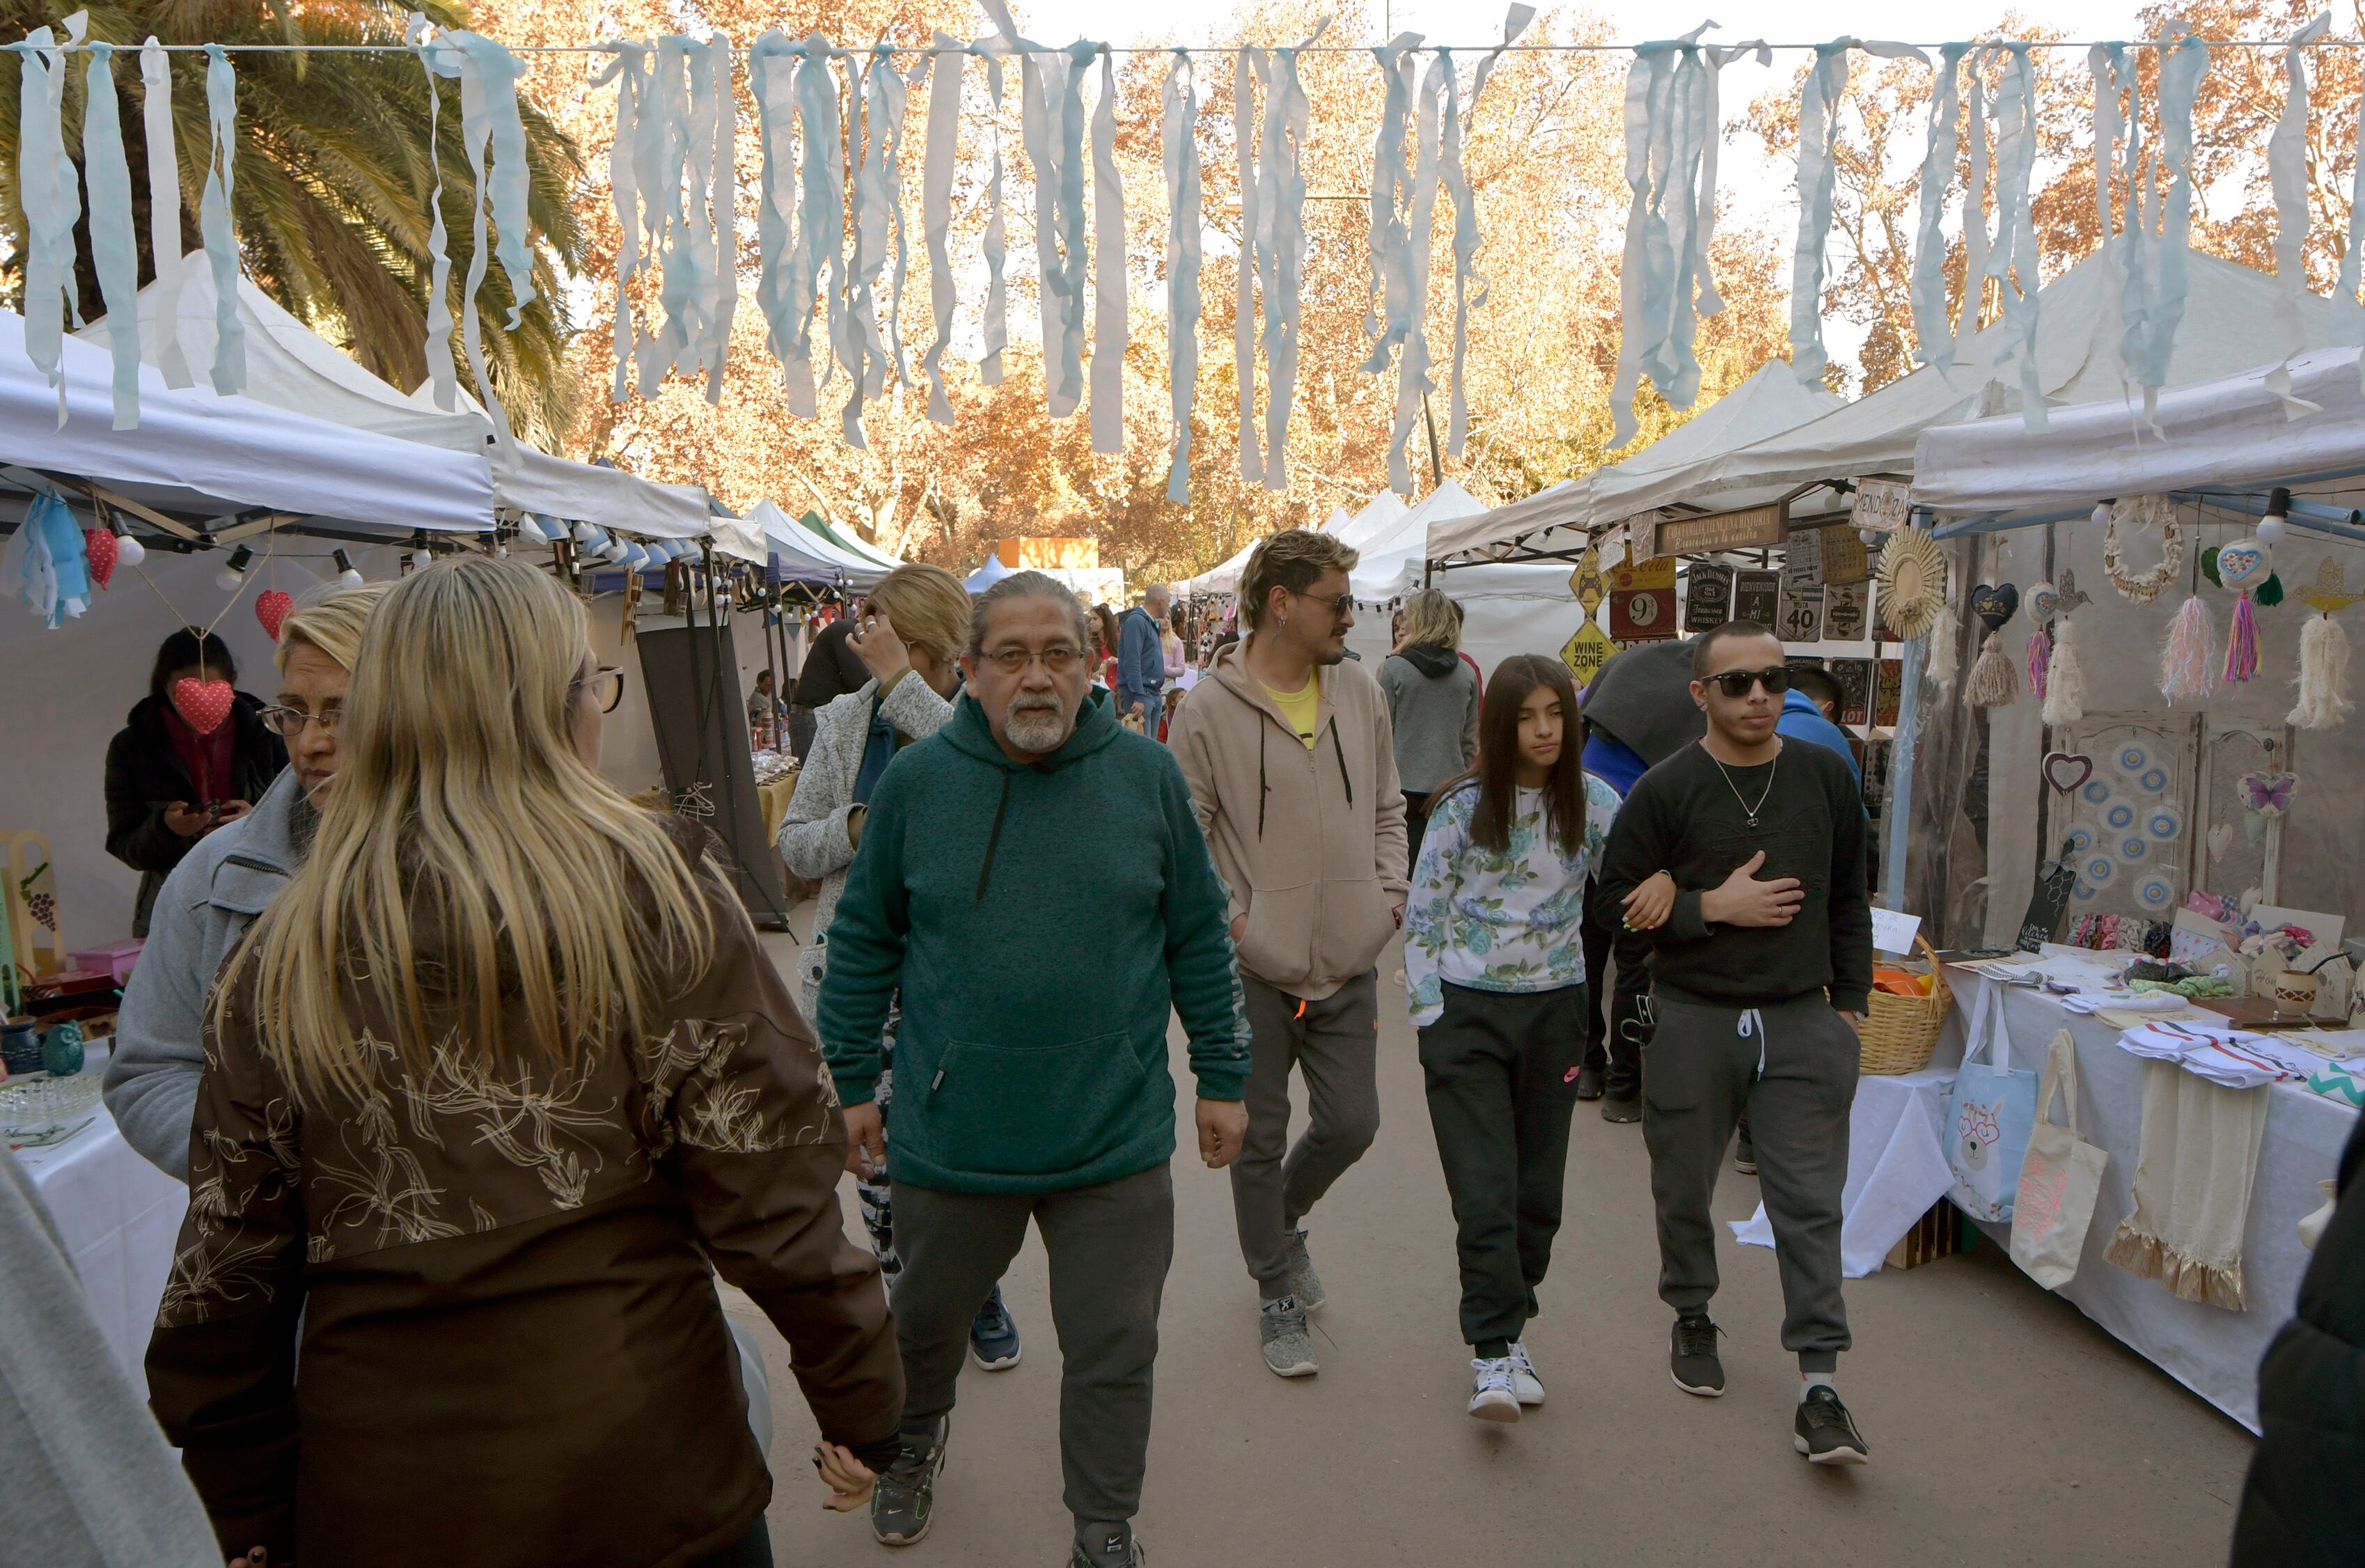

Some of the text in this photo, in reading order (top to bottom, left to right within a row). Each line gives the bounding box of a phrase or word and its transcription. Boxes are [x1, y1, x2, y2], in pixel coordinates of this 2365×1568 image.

[1853, 492, 1906, 517] MENDOZA
[1740, 511, 1770, 529] HISTORIA
[1741, 581, 1776, 592] BIENVENIDOS
[1631, 597, 1647, 620] 9
[1752, 597, 1759, 606] A
[1750, 609, 1761, 620] MI
[1787, 609, 1814, 633] 40
[1574, 642, 1603, 654] WINE
[1573, 655, 1603, 668] ZONE
[2254, 969, 2276, 987] Hom
